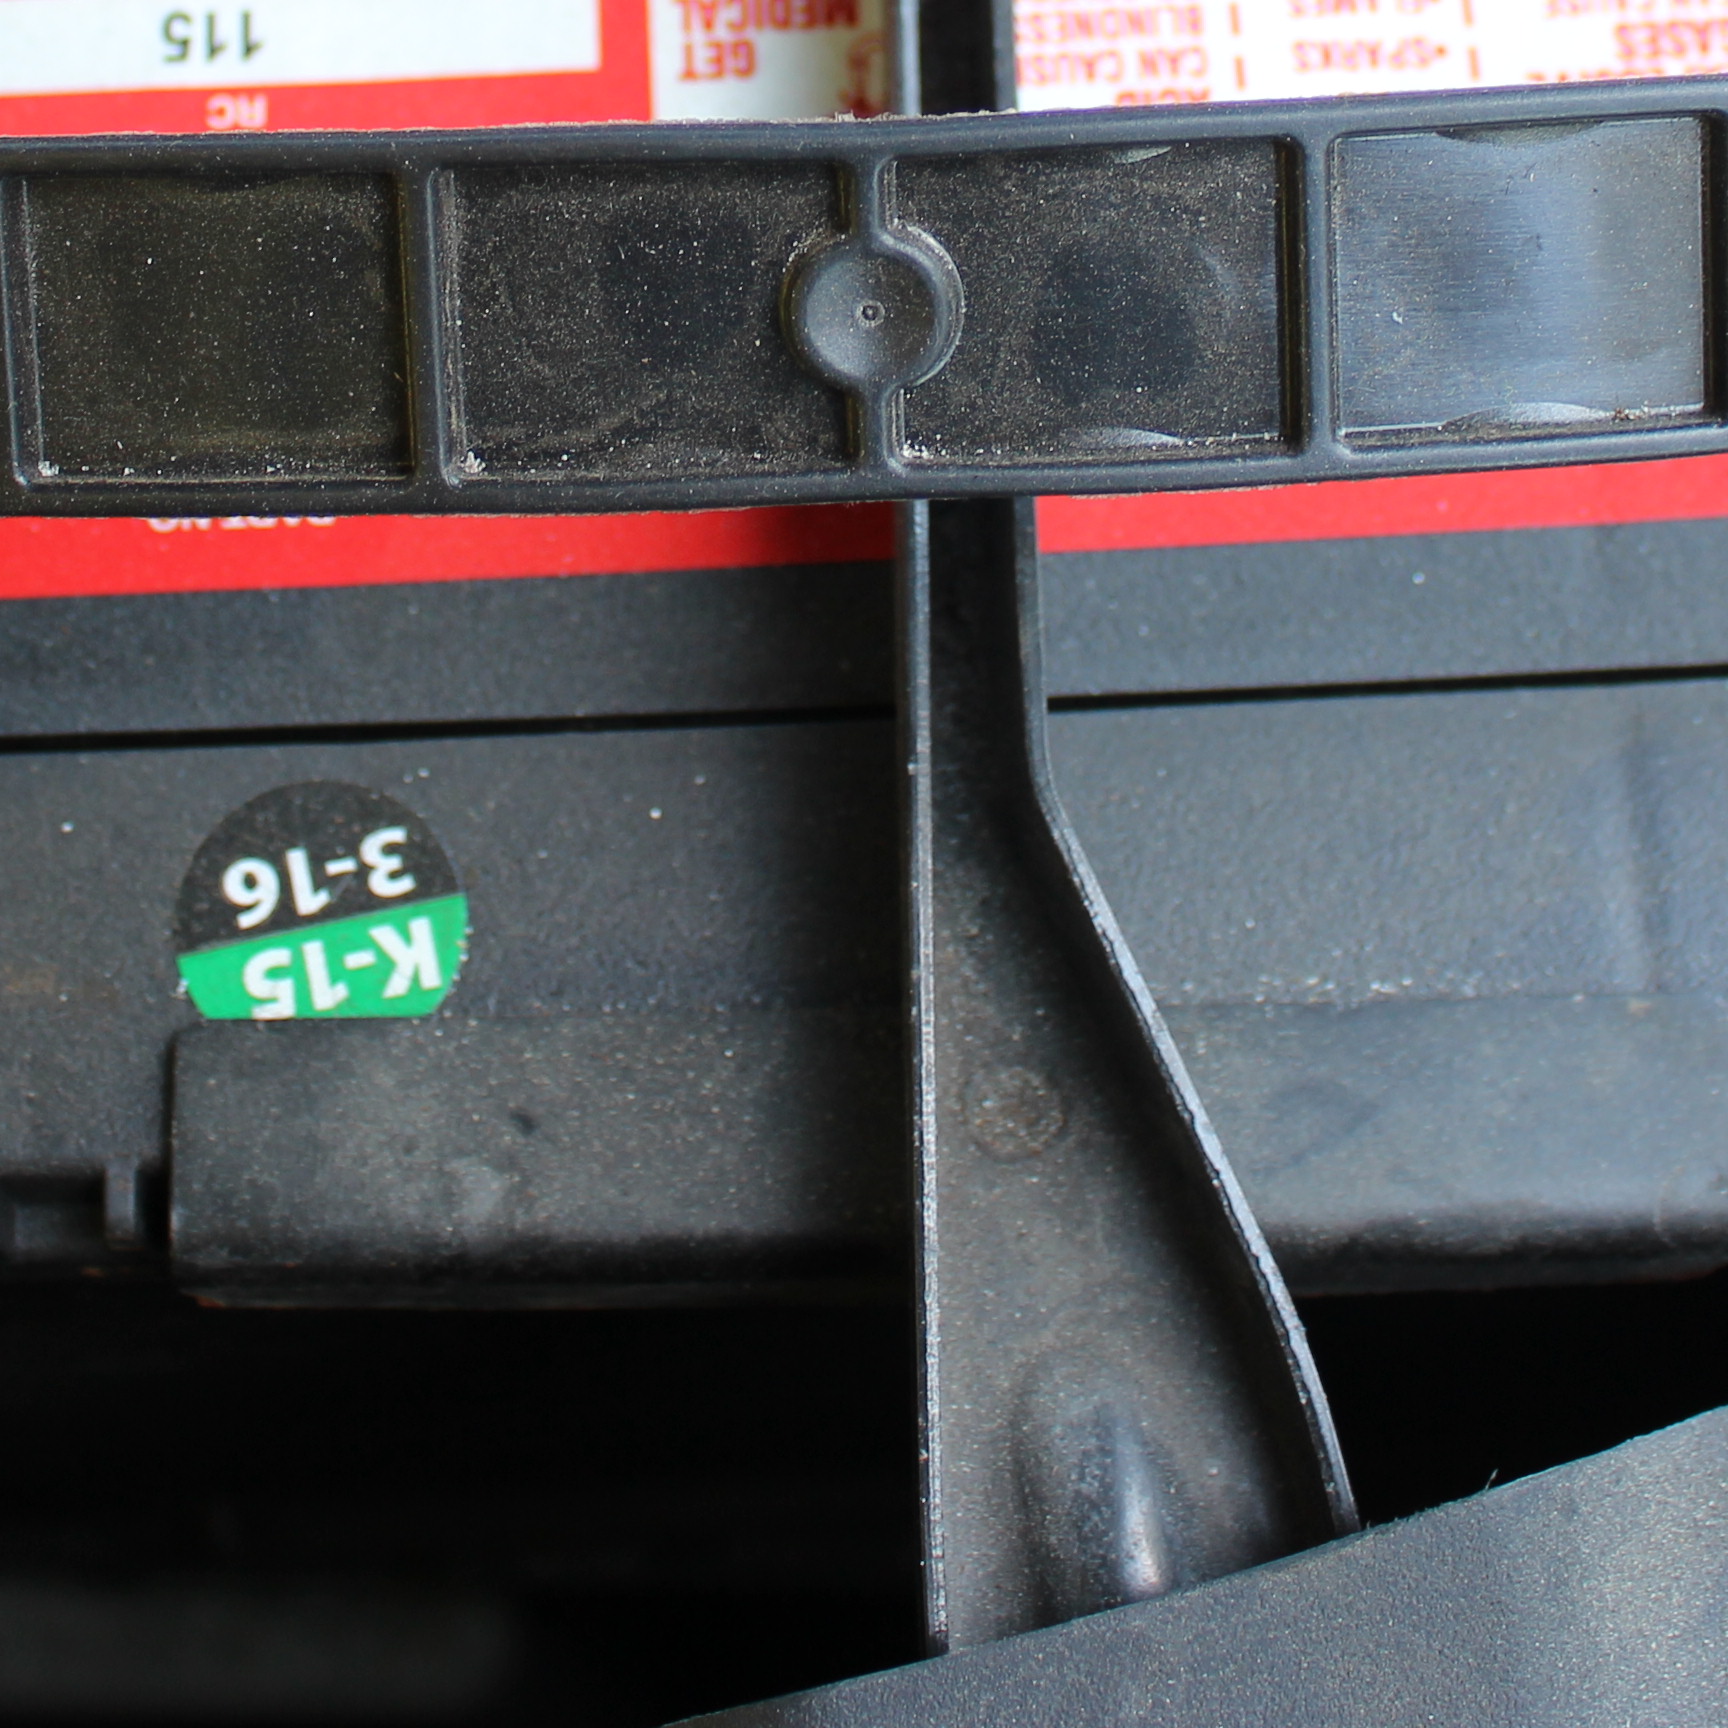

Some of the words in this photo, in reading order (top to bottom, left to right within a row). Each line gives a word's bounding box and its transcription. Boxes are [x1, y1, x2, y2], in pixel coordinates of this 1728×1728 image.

[158, 9, 263, 65] 115
[1290, 36, 1434, 73] SPARKS
[677, 38, 757, 82] GET
[1137, 44, 1208, 80] CAN
[205, 93, 269, 128] RC
[220, 825, 417, 930] 3-16
[241, 915, 443, 1022] K-15
